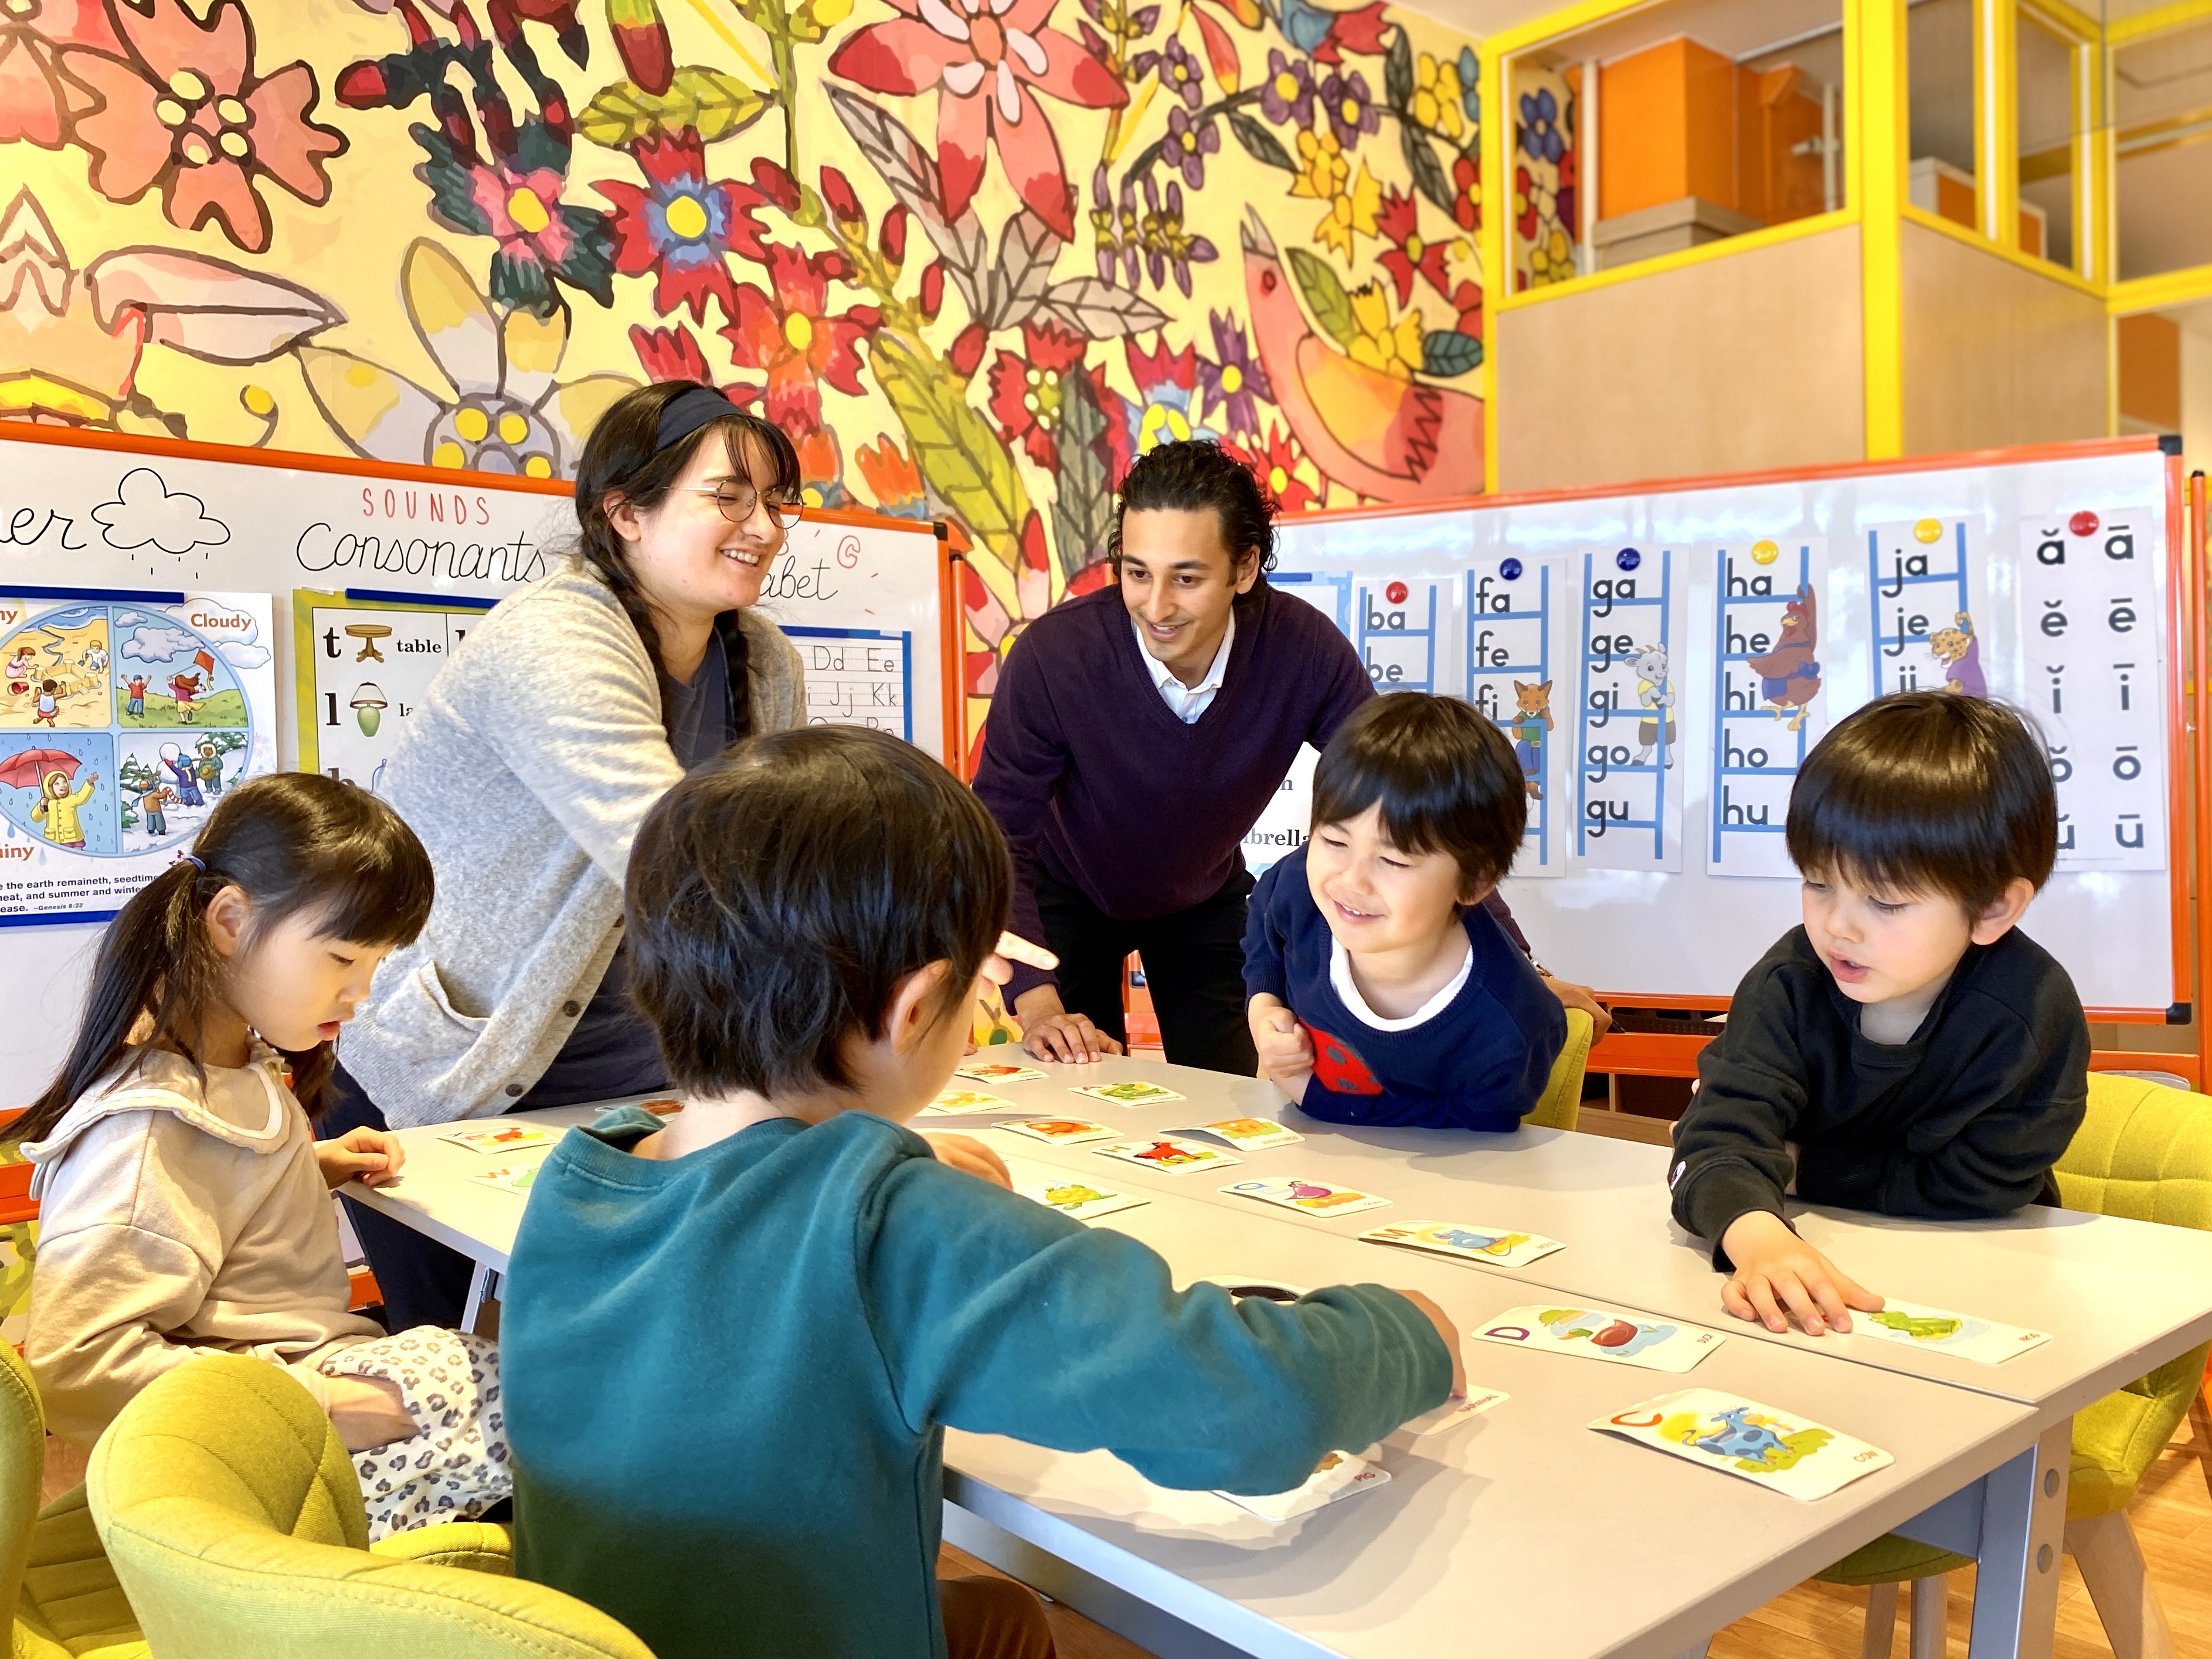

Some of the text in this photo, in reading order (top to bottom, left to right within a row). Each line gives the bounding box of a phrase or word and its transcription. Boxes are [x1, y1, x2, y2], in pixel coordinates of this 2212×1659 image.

[362, 488, 490, 525] SOUNDS
[296, 522, 546, 583] Consonants
[2105, 525, 2134, 560] ā
[760, 555, 838, 600] abet
[1727, 557, 1772, 597] ha
[1881, 548, 1928, 599] ja
[1367, 594, 1406, 631] ba
[1475, 576, 1511, 614] fa
[1592, 579, 1636, 618] ga
[190, 613, 252, 631] Cloudy
[1725, 614, 1771, 654] he
[1883, 607, 1929, 657] je
[2108, 597, 2136, 633] ē
[322, 627, 442, 658] t table
[1474, 630, 1510, 668] fe
[1590, 634, 1634, 674] ge
[1366, 646, 1404, 683] be
[399, 703, 413, 717] la
[1589, 682, 1619, 728] gi
[1725, 671, 1756, 711] hi
[1587, 744, 1631, 783] go
[1724, 727, 1769, 768] ho
[2112, 746, 2142, 781] ō
[1586, 800, 1629, 838] gu
[1722, 784, 1769, 826] hu
[2115, 814, 2144, 849] ū
[6, 882, 23, 890] the
[26, 879, 54, 889] earth
[57, 876, 111, 887] remaineth,
[26, 891, 45, 900] and
[48, 889, 90, 899] summer
[93, 887, 111, 896] and
[114, 886, 144, 895] winte
[0, 905, 29, 913] ease.
[1368, 1228, 1416, 1240] M
[1484, 1326, 1530, 1341] D
[1610, 1410, 1880, 1463] C COW
[1354, 1471, 1376, 1482] PIG
